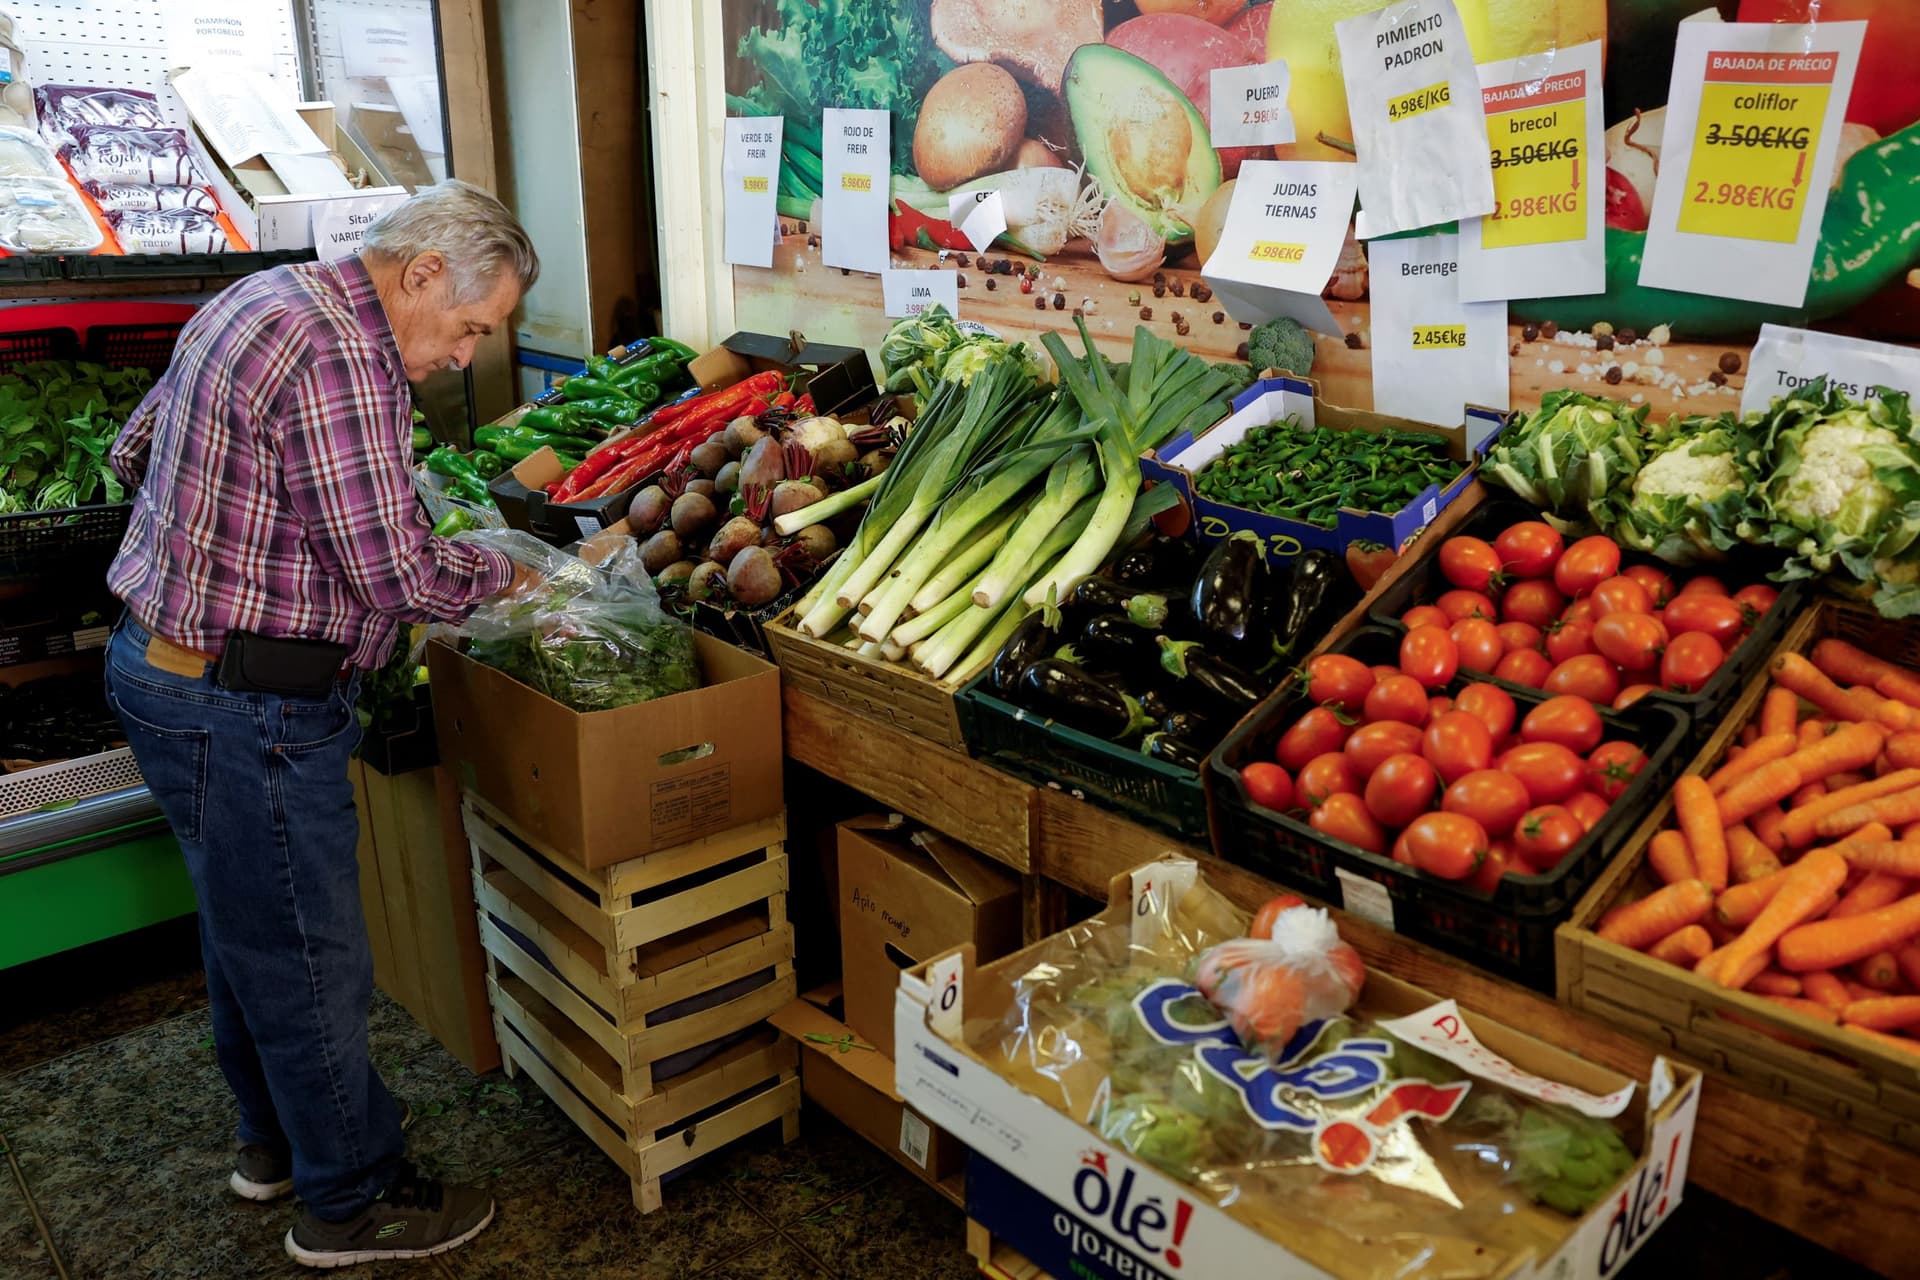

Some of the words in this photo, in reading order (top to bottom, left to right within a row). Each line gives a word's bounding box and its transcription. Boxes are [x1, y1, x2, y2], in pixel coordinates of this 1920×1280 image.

[195, 27, 245, 37] PORTOBELLO
[1376, 13, 1443, 49] PIMIENTO
[1384, 38, 1444, 71] PADRON
[1712, 57, 1766, 71] BAJADA
[1768, 58, 1786, 71] DE
[1788, 58, 1832, 72] PRECIO
[1246, 84, 1280, 102] PUERRO
[1483, 86, 1525, 104] BAJADA
[1544, 75, 1582, 93] PRECIO
[1388, 87, 1450, 119] 4,98€/KG
[1733, 92, 1799, 111] coliflor
[1509, 111, 1557, 134] brecol
[740, 132, 763, 143] VERDE
[764, 132, 774, 143] DE
[843, 126, 862, 137] ROJO
[863, 126, 874, 138] DE
[1705, 123, 1811, 150] 3.50€KG
[747, 148, 767, 159] FREIR
[846, 143, 868, 155] FREIR
[1490, 138, 1579, 169] 3.50€KG
[1273, 183, 1318, 198] JUDIAS
[1694, 181, 1797, 211] 2.98€KG
[1265, 204, 1317, 219] TIERNAS
[1491, 191, 1578, 221] 2.98€KG
[348, 213, 378, 225] Sitak
[330, 230, 364, 243] VARIE
[1250, 245, 1305, 261] 4.98€KG
[1401, 260, 1458, 277] Berenge
[911, 287, 931, 297] LIMA
[1412, 329, 1466, 346] 2.45€kg
